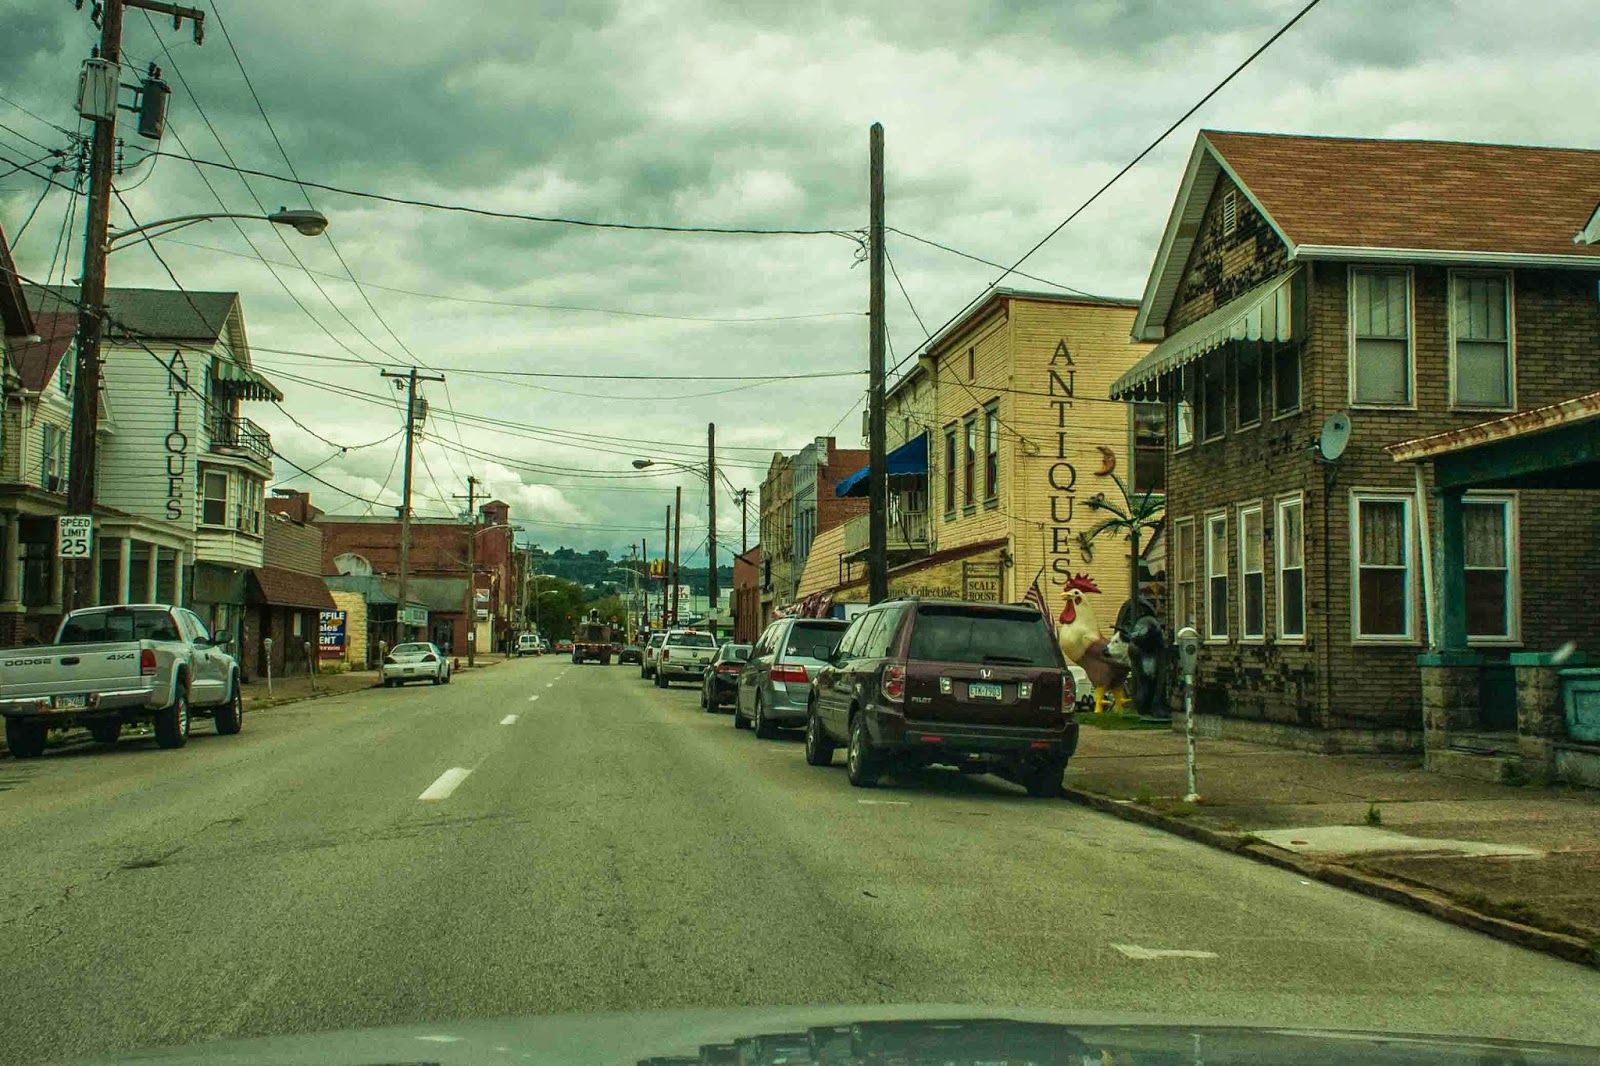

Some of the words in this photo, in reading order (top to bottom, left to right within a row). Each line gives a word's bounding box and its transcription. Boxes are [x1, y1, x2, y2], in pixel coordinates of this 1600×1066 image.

[166, 349, 190, 520] ANTIQUES
[1048, 338, 1077, 585] ANTIQUES
[60, 518, 90, 527] SPEED
[62, 529, 87, 537] LIMIT
[61, 539, 87, 555] 25
[969, 581, 997, 590] SCALE
[911, 585, 960, 598] Collectibles
[969, 592, 997, 601] HOUSE
[5, 658, 52, 666] DODGE
